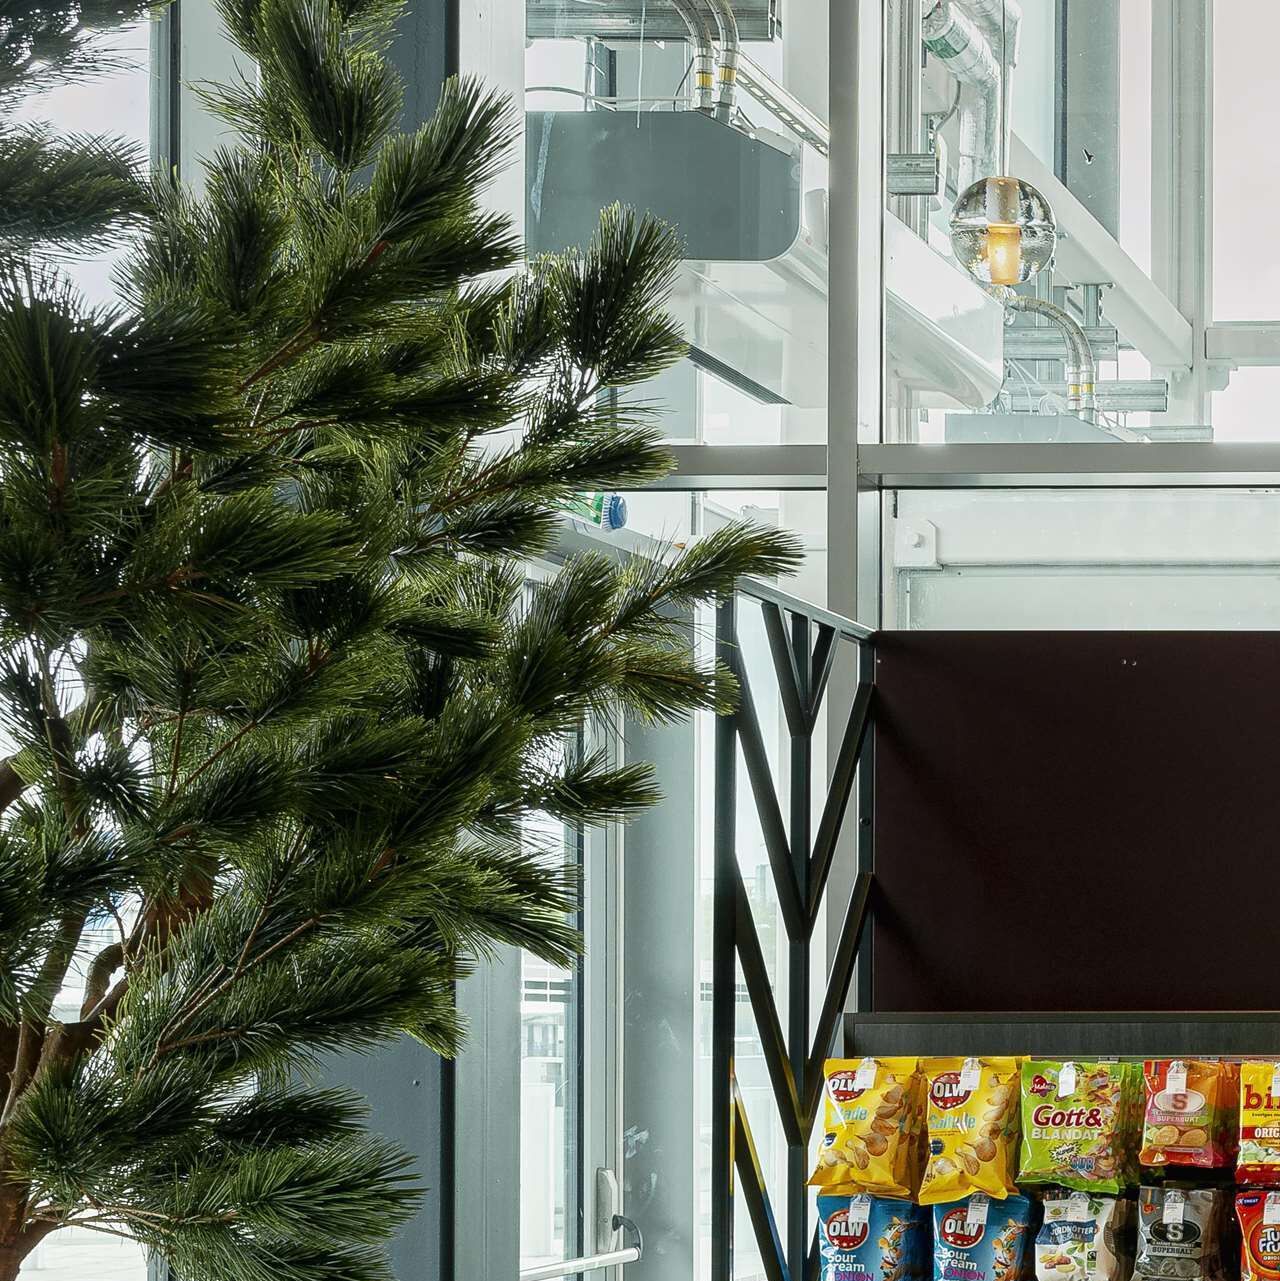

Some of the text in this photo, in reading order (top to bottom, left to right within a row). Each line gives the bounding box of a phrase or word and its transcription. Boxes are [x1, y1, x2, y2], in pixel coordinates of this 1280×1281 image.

[1033, 1104, 1103, 1128] Gott&
[1032, 1128, 1100, 1140] BLANDAT
[829, 1222, 864, 1237] OLW
[944, 1219, 979, 1235] OLW
